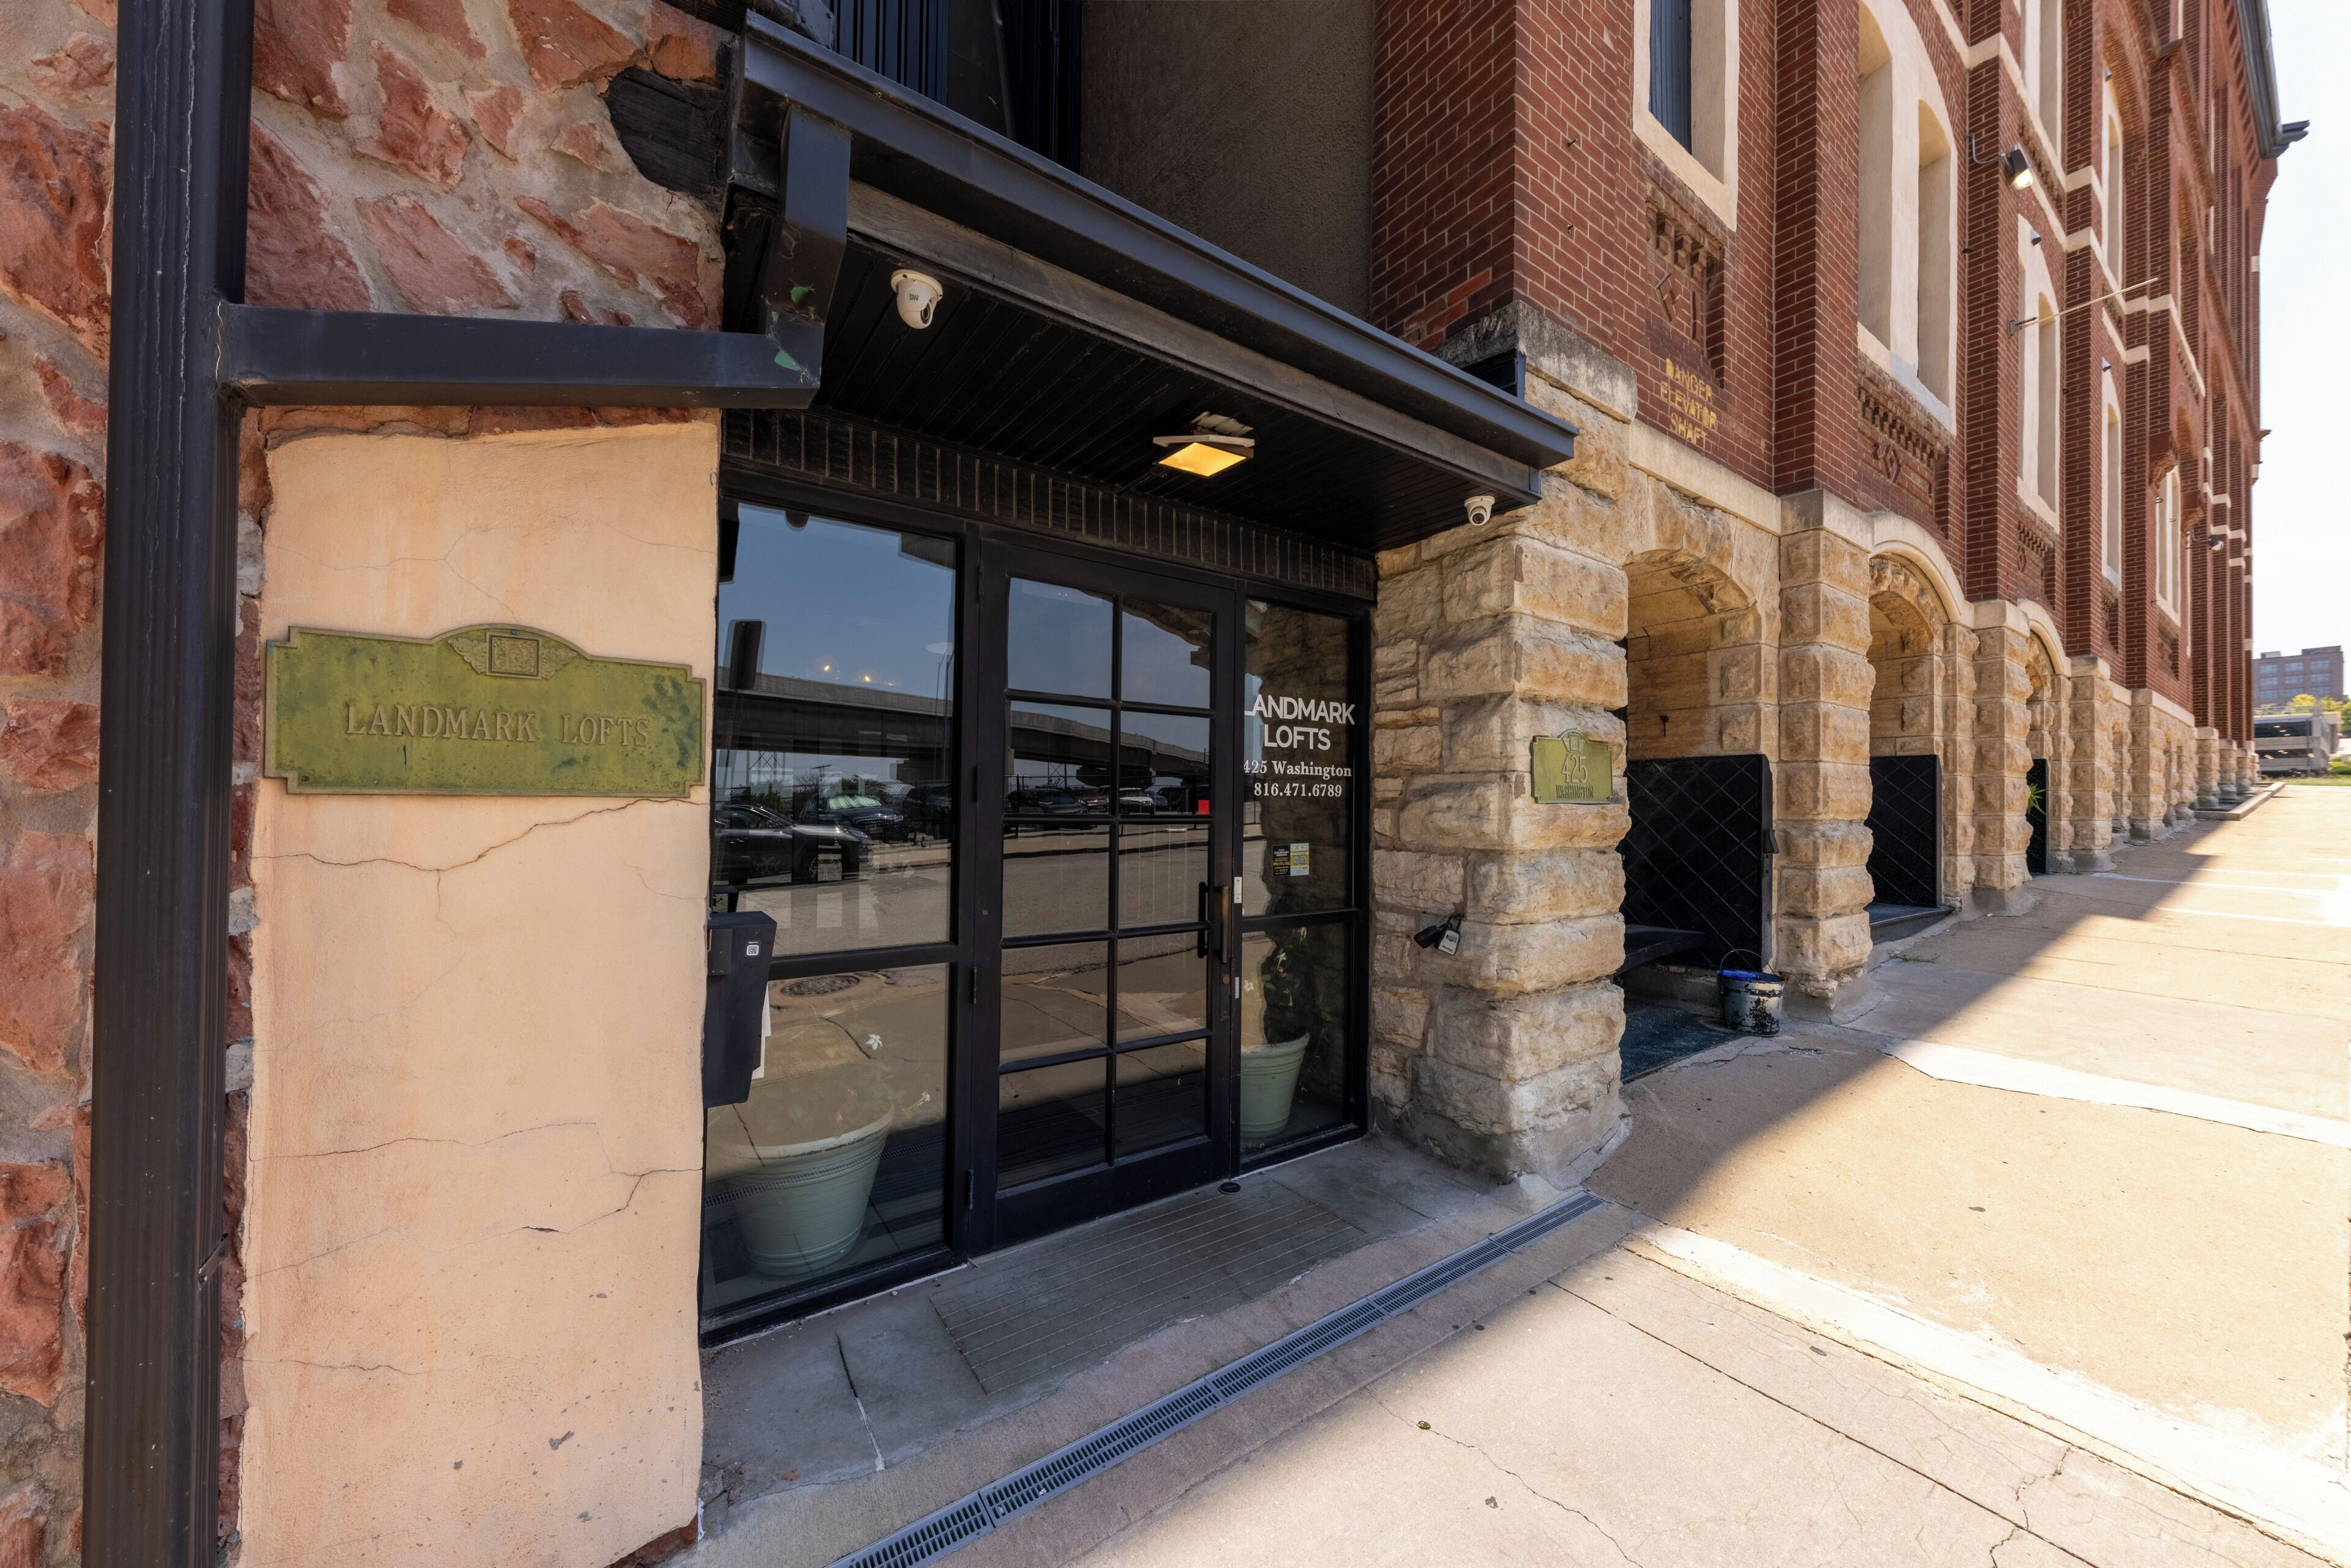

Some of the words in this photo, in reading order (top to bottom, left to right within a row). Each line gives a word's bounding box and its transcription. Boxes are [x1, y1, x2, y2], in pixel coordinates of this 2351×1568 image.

[1666, 358, 1713, 405] DANGER
[1660, 380, 1718, 430] ELEVATOR
[1670, 413, 1708, 449] SHAFT
[345, 702, 536, 743] LANDMARK
[561, 715, 650, 747] LOFTS
[1264, 724, 1331, 751] LOFTS
[1243, 759, 1267, 774] 425
[1272, 760, 1352, 780] Washington
[1561, 754, 1588, 783] 425
[1254, 782, 1342, 797] 816.471.6789
[1555, 784, 1594, 799] WASHINGTON
